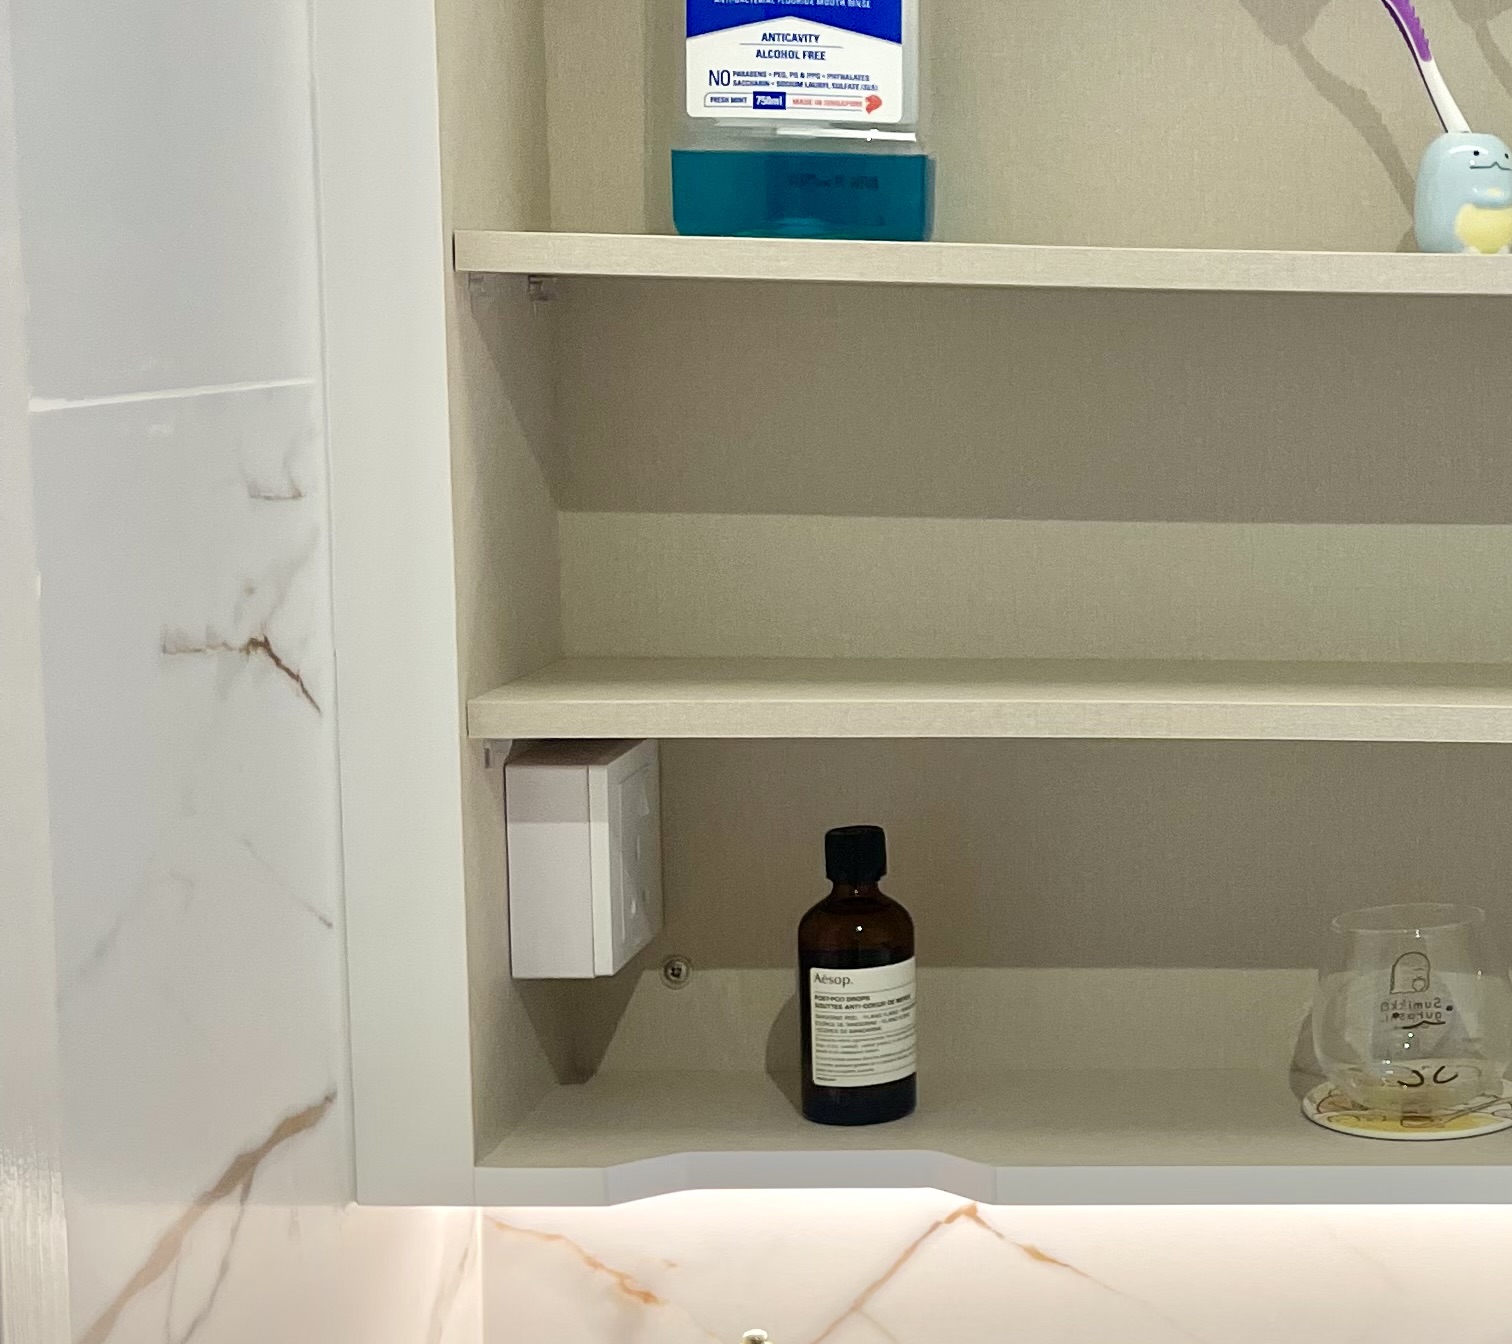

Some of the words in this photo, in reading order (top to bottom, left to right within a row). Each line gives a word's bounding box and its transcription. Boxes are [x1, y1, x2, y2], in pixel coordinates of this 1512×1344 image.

[761, 32, 820, 43] ANTICAVITY
[755, 49, 800, 60] ALCOHOL
[802, 50, 826, 60] FREE
[708, 69, 731, 87] NO
